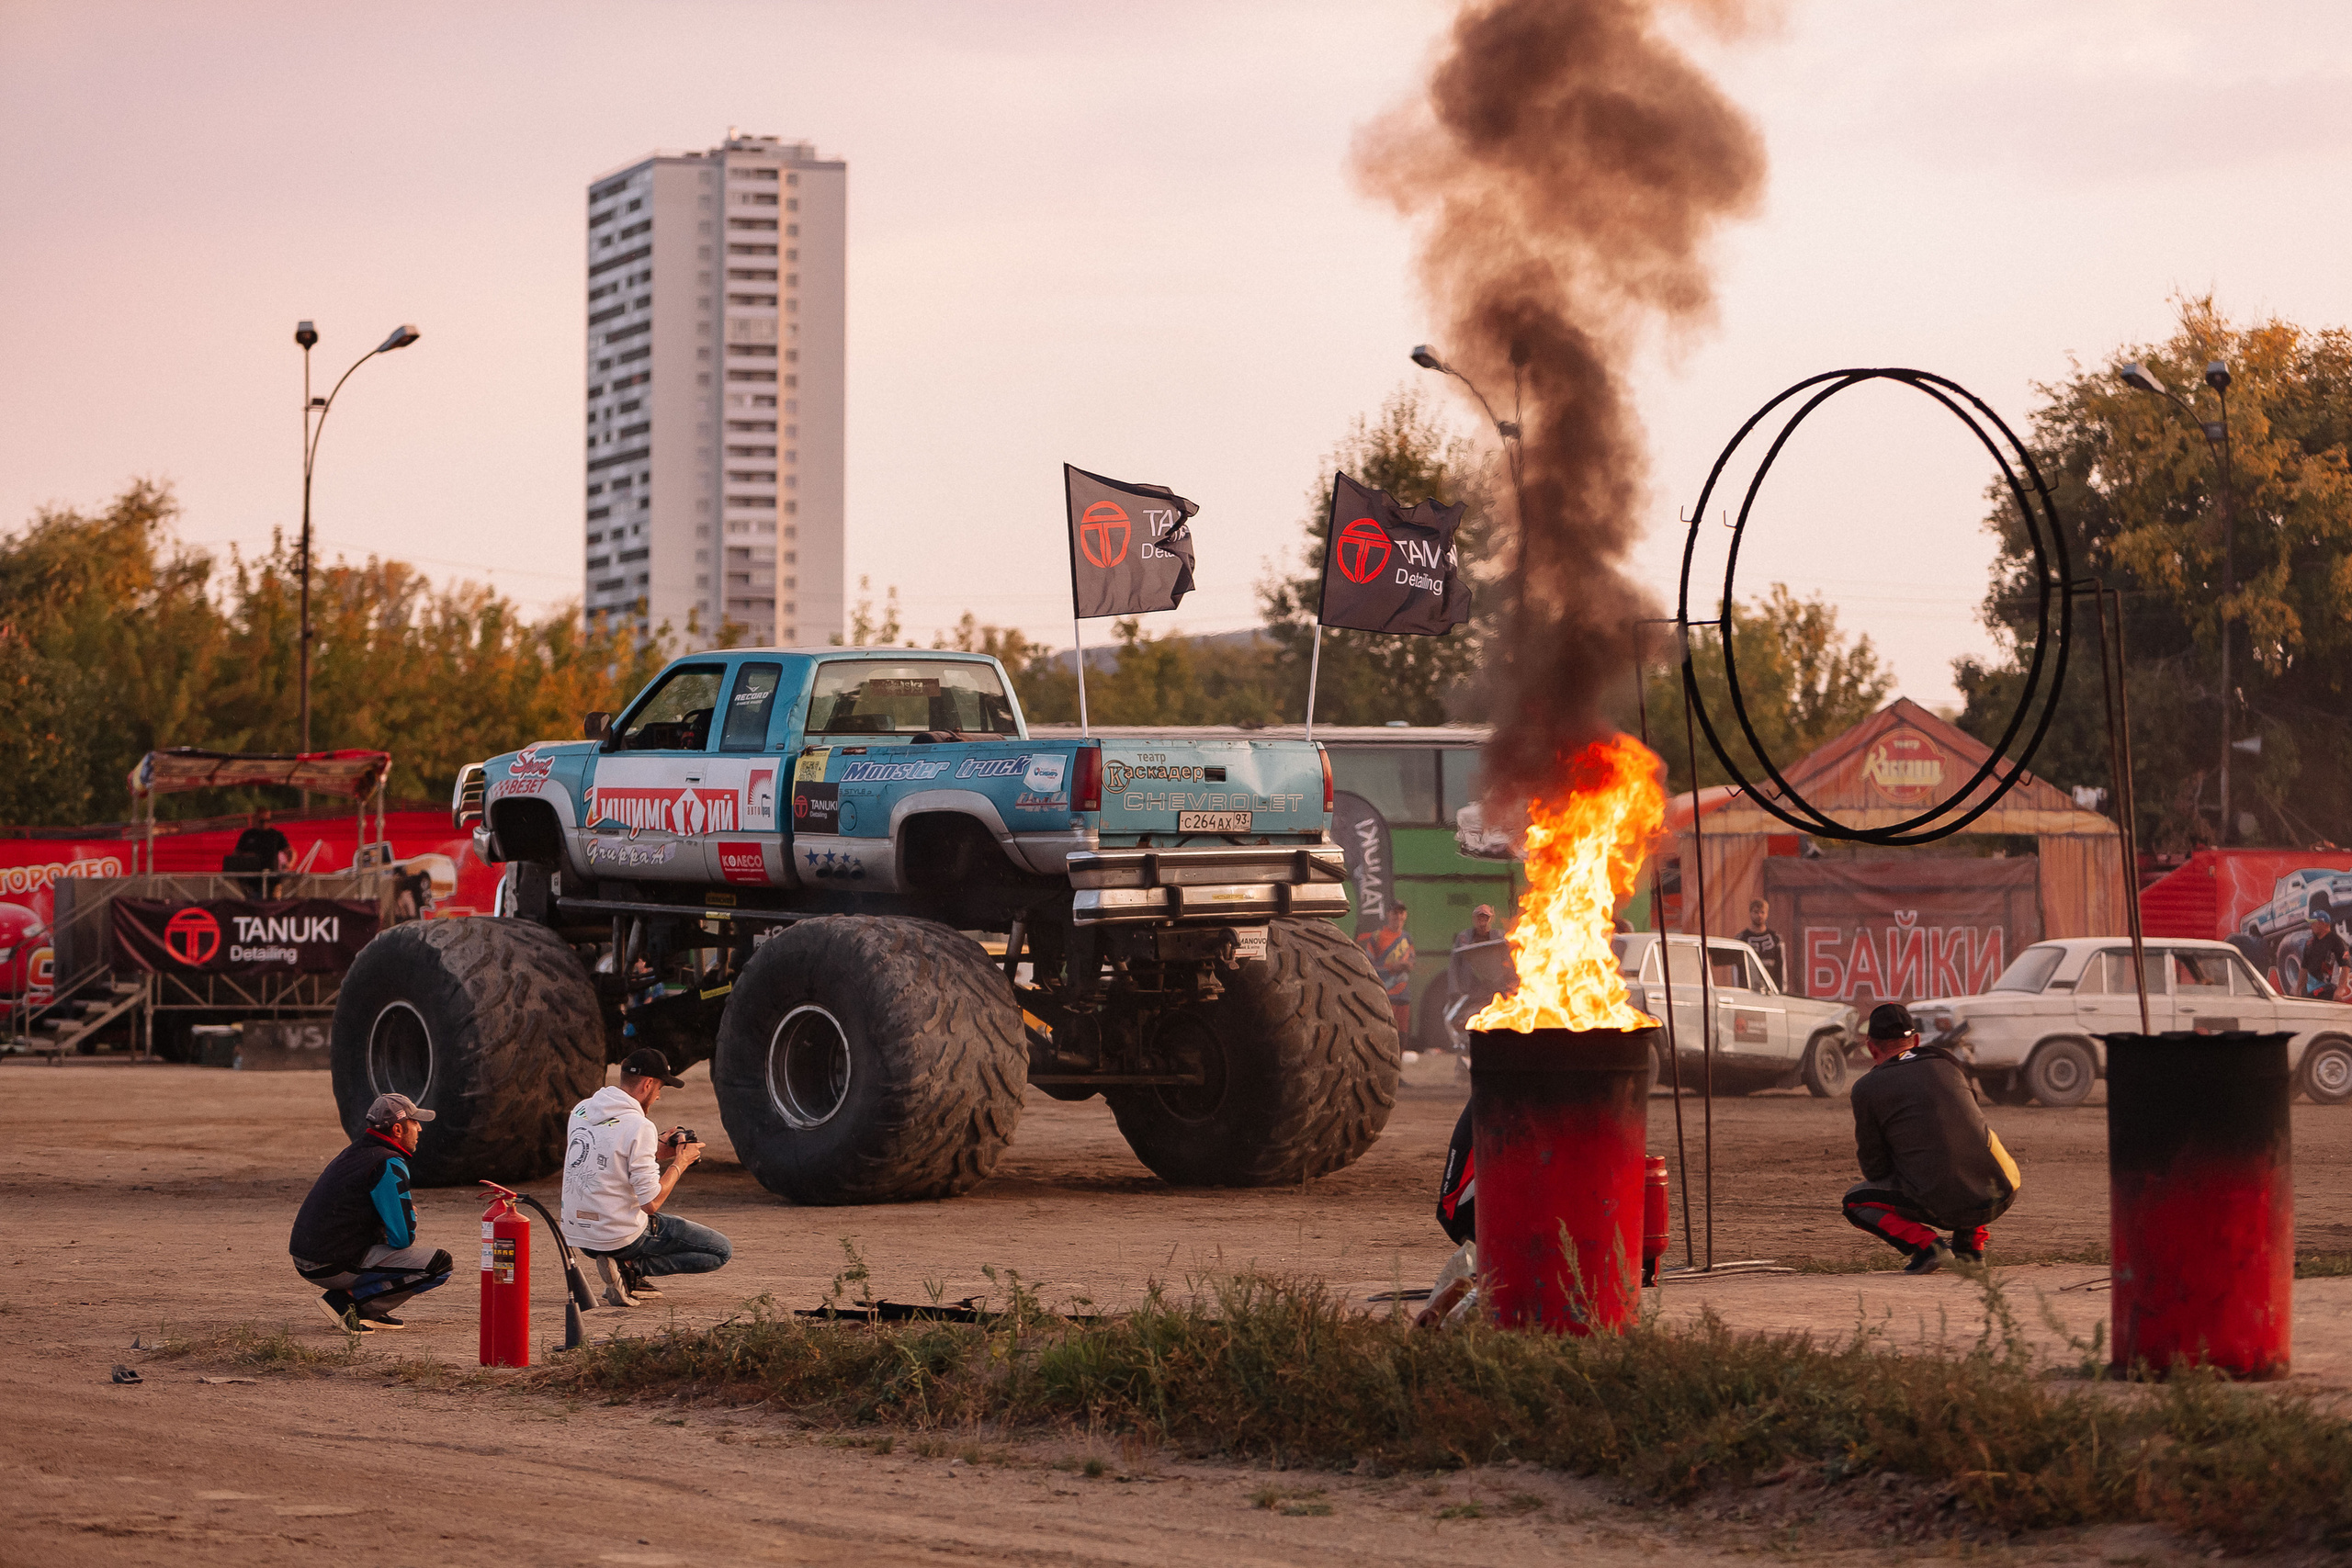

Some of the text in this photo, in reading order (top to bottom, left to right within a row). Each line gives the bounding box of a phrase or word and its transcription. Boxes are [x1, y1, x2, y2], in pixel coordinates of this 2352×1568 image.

[734, 691, 769, 702] RECORD
[508, 749, 555, 779] Sport
[1136, 753, 1167, 764] театр
[841, 755, 1033, 782] Monster truck
[1103, 761, 1204, 793] Каскадер
[809, 799, 838, 811] TANUKI
[1123, 792, 1304, 812] CHEVROLET
[1235, 814, 1248, 825] 93
[721, 854, 763, 867] КОЛЕСО
[232, 916, 339, 943] TANUKI
[230, 945, 298, 964] Detailing
[1804, 909, 2004, 1001] БАЙКИ
